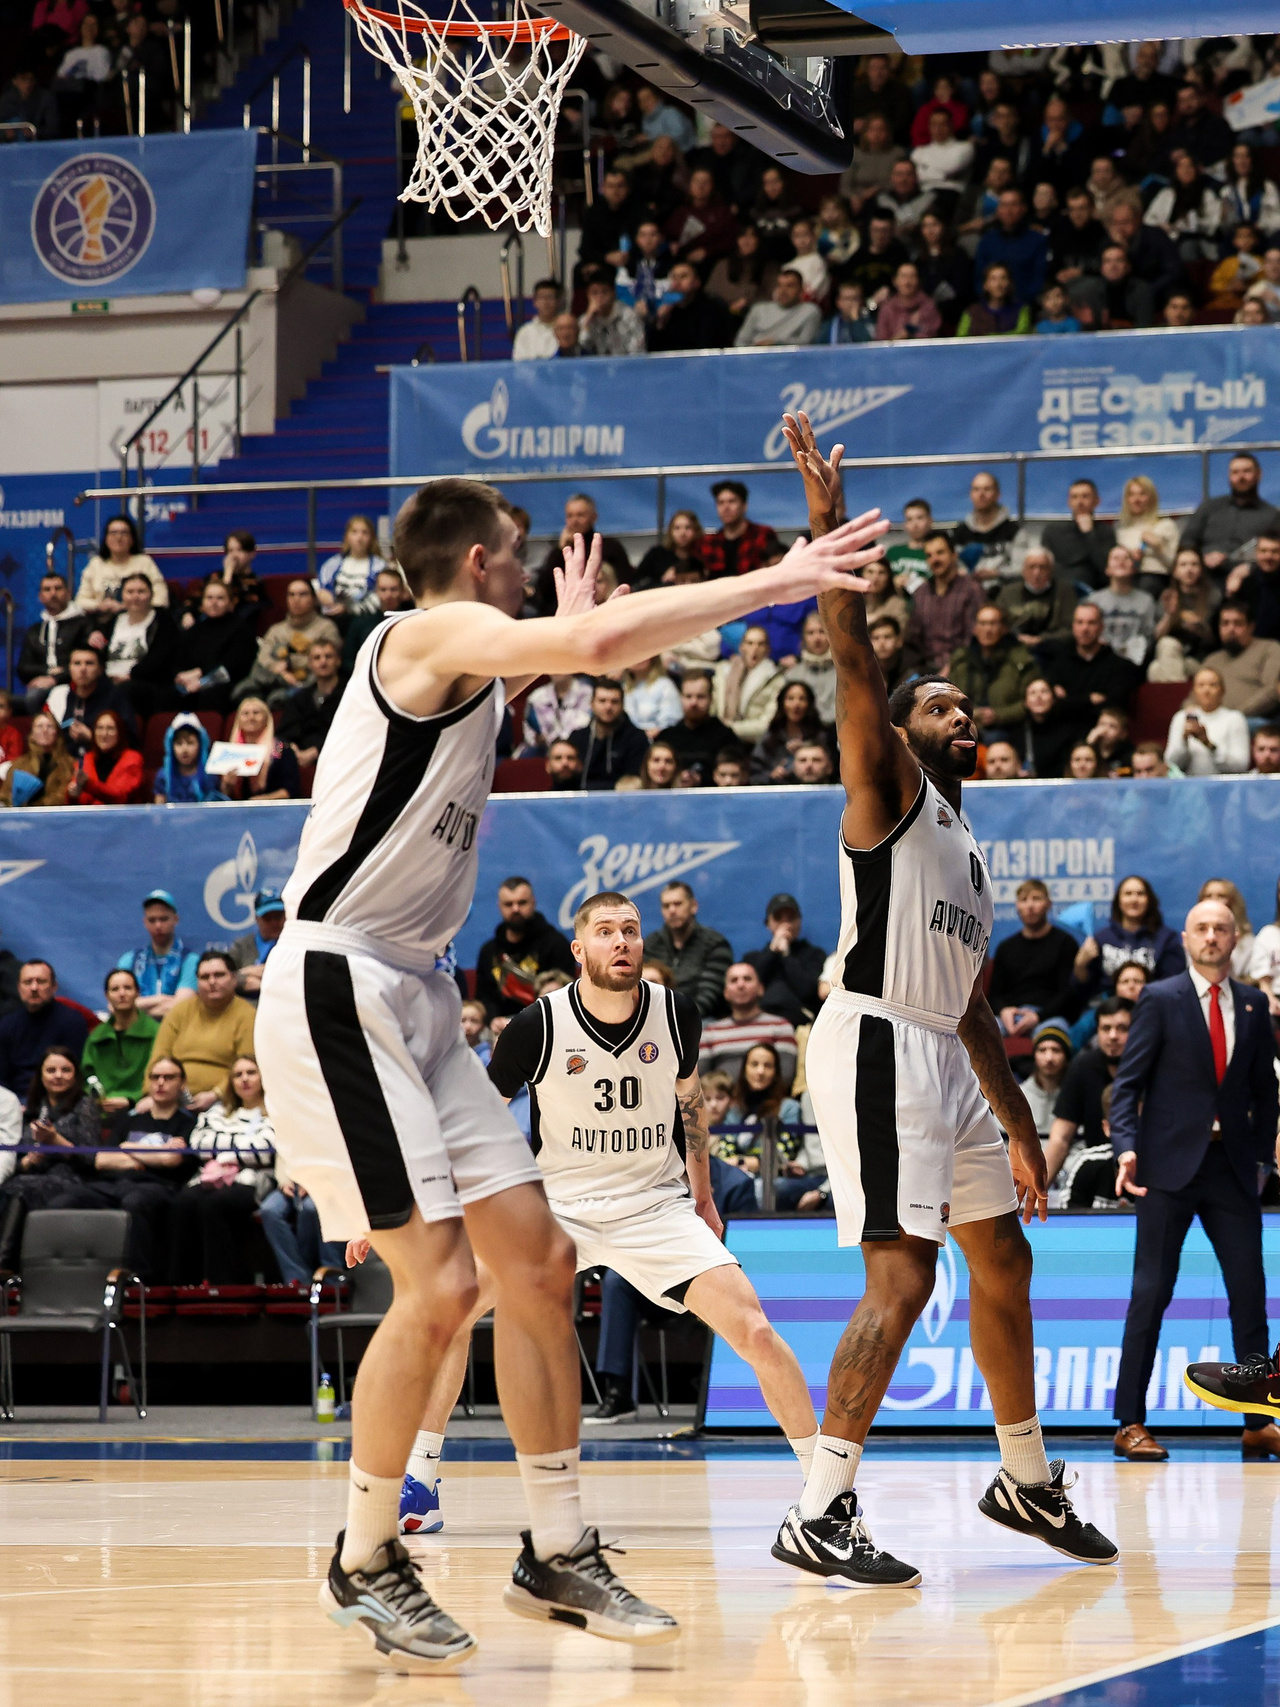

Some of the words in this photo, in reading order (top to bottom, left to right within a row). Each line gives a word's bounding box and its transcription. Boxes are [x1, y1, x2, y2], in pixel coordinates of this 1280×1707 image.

[1038, 373, 1266, 423] ДЕСЯТЫЙ
[508, 425, 625, 459] ГАЗПРОМ
[1039, 418, 1196, 450] СЕЗОН
[594, 1076, 642, 1113] 30
[571, 1122, 667, 1154] AVTODOR
[955, 1346, 1222, 1412] ГЗПРМ
